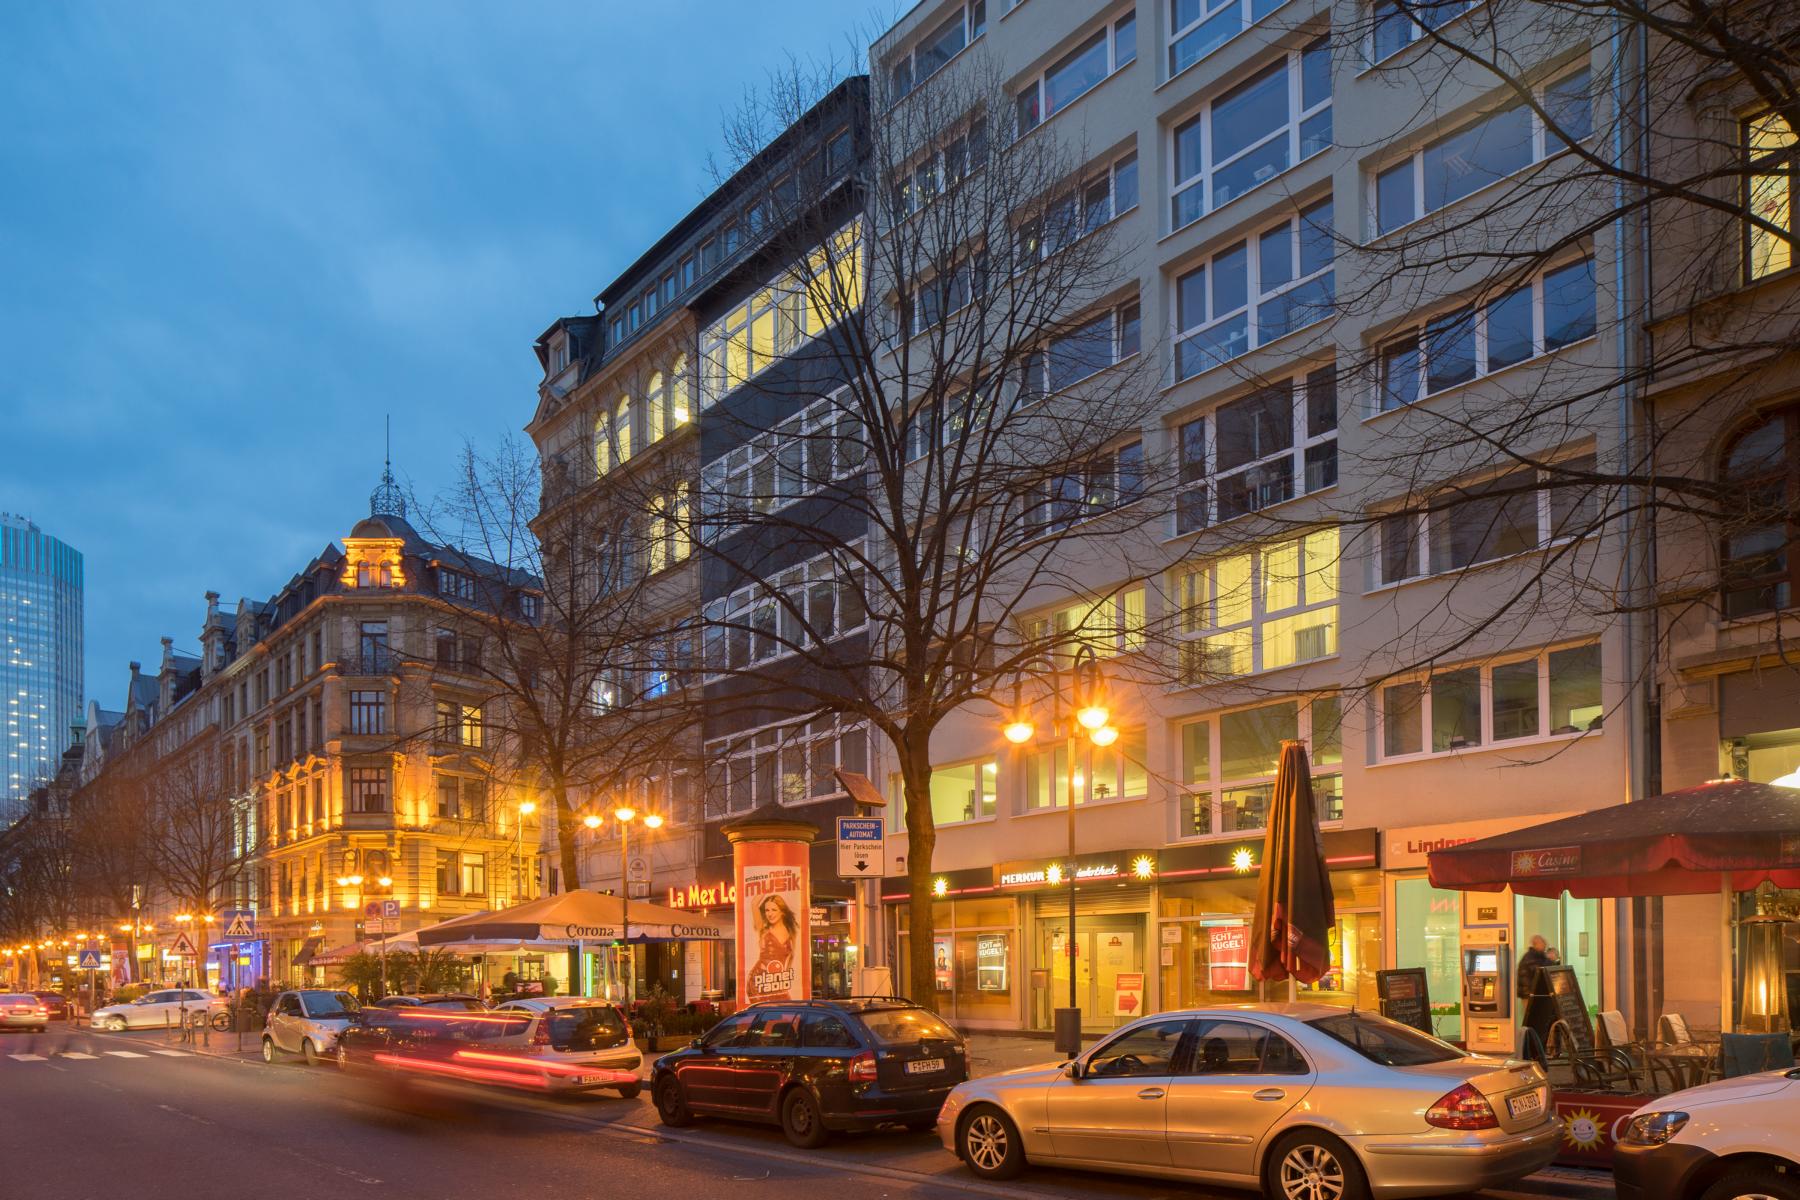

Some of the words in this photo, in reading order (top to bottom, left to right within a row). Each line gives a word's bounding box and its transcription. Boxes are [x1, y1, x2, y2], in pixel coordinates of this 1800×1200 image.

[843, 822, 880, 830] PARKSCHEIN-
[1407, 838, 1478, 854] Lindn
[854, 851, 868, 859] lösen
[1537, 852, 1578, 868] Casino
[769, 870, 792, 878] neue
[1001, 871, 1045, 885] MERKUR
[745, 873, 801, 897] musik
[669, 887, 685, 908] La
[688, 884, 717, 907] Mex
[565, 923, 614, 938] Corona
[671, 924, 720, 938] Corona
[1211, 932, 1231, 942] ECHT
[1211, 940, 1244, 951] KUGEL!
[755, 967, 795, 987] planet
[758, 980, 792, 994] radio
